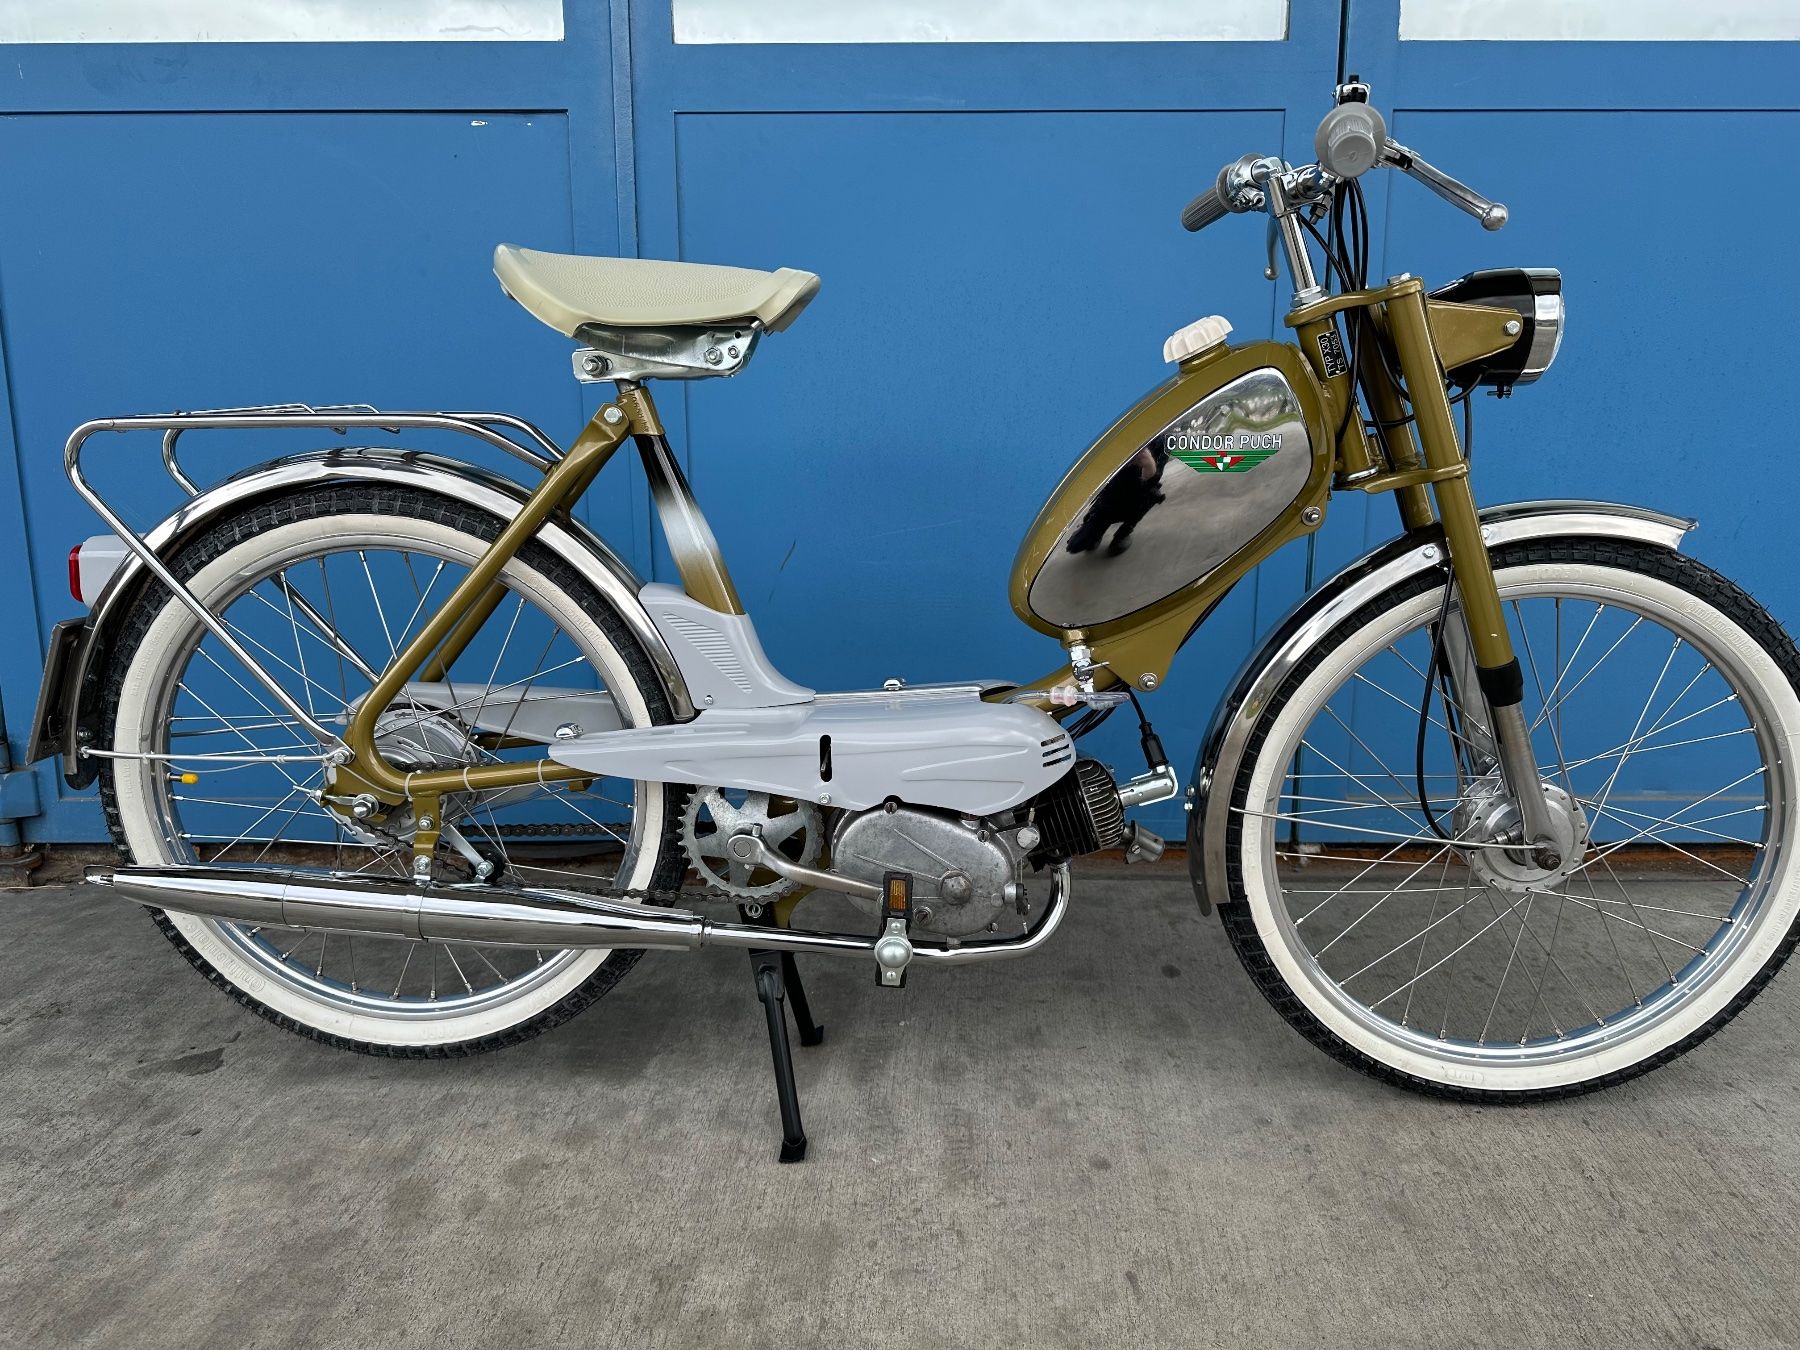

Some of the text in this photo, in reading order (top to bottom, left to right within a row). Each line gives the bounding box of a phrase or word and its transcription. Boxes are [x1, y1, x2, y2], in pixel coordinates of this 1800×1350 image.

[1320, 337, 1336, 373] TYP X30
[1331, 334, 1344, 370] TS 7053
[1166, 433, 1283, 450] CONDOR PUCH
[1680, 599, 1758, 660] Continental
